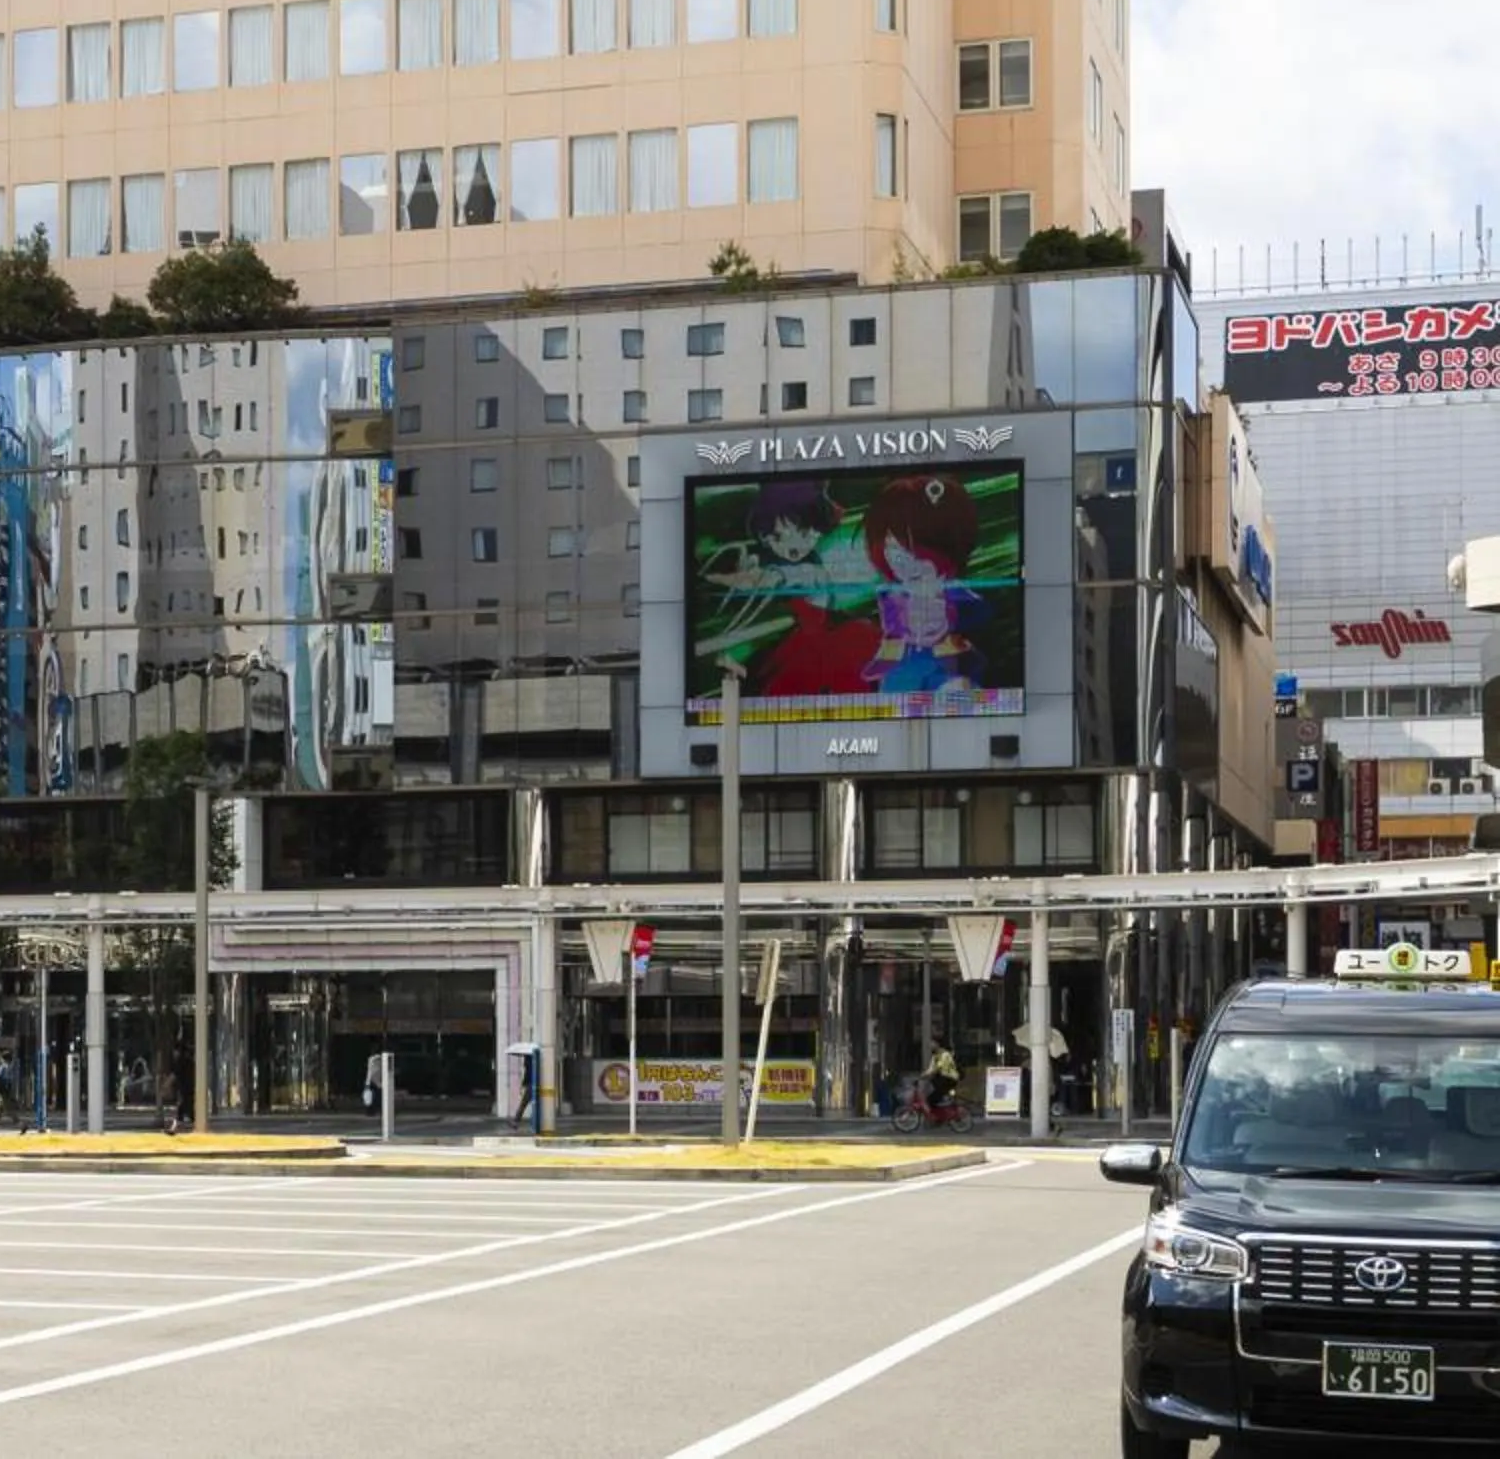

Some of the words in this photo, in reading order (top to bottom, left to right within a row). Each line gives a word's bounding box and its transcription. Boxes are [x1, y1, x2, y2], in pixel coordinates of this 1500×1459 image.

[1227, 301, 1500, 353] ヨドバシカメ
[1349, 352, 1400, 373] あさ
[759, 435, 845, 462] PLAZA
[855, 428, 947, 455] VISION
[826, 736, 879, 754] AKAMI
[1291, 763, 1315, 790] P
[1348, 954, 1380, 970] ユー
[1425, 955, 1459, 971] トク
[1383, 1350, 1411, 1364] 500
[1348, 1366, 1428, 1395] 61-50
